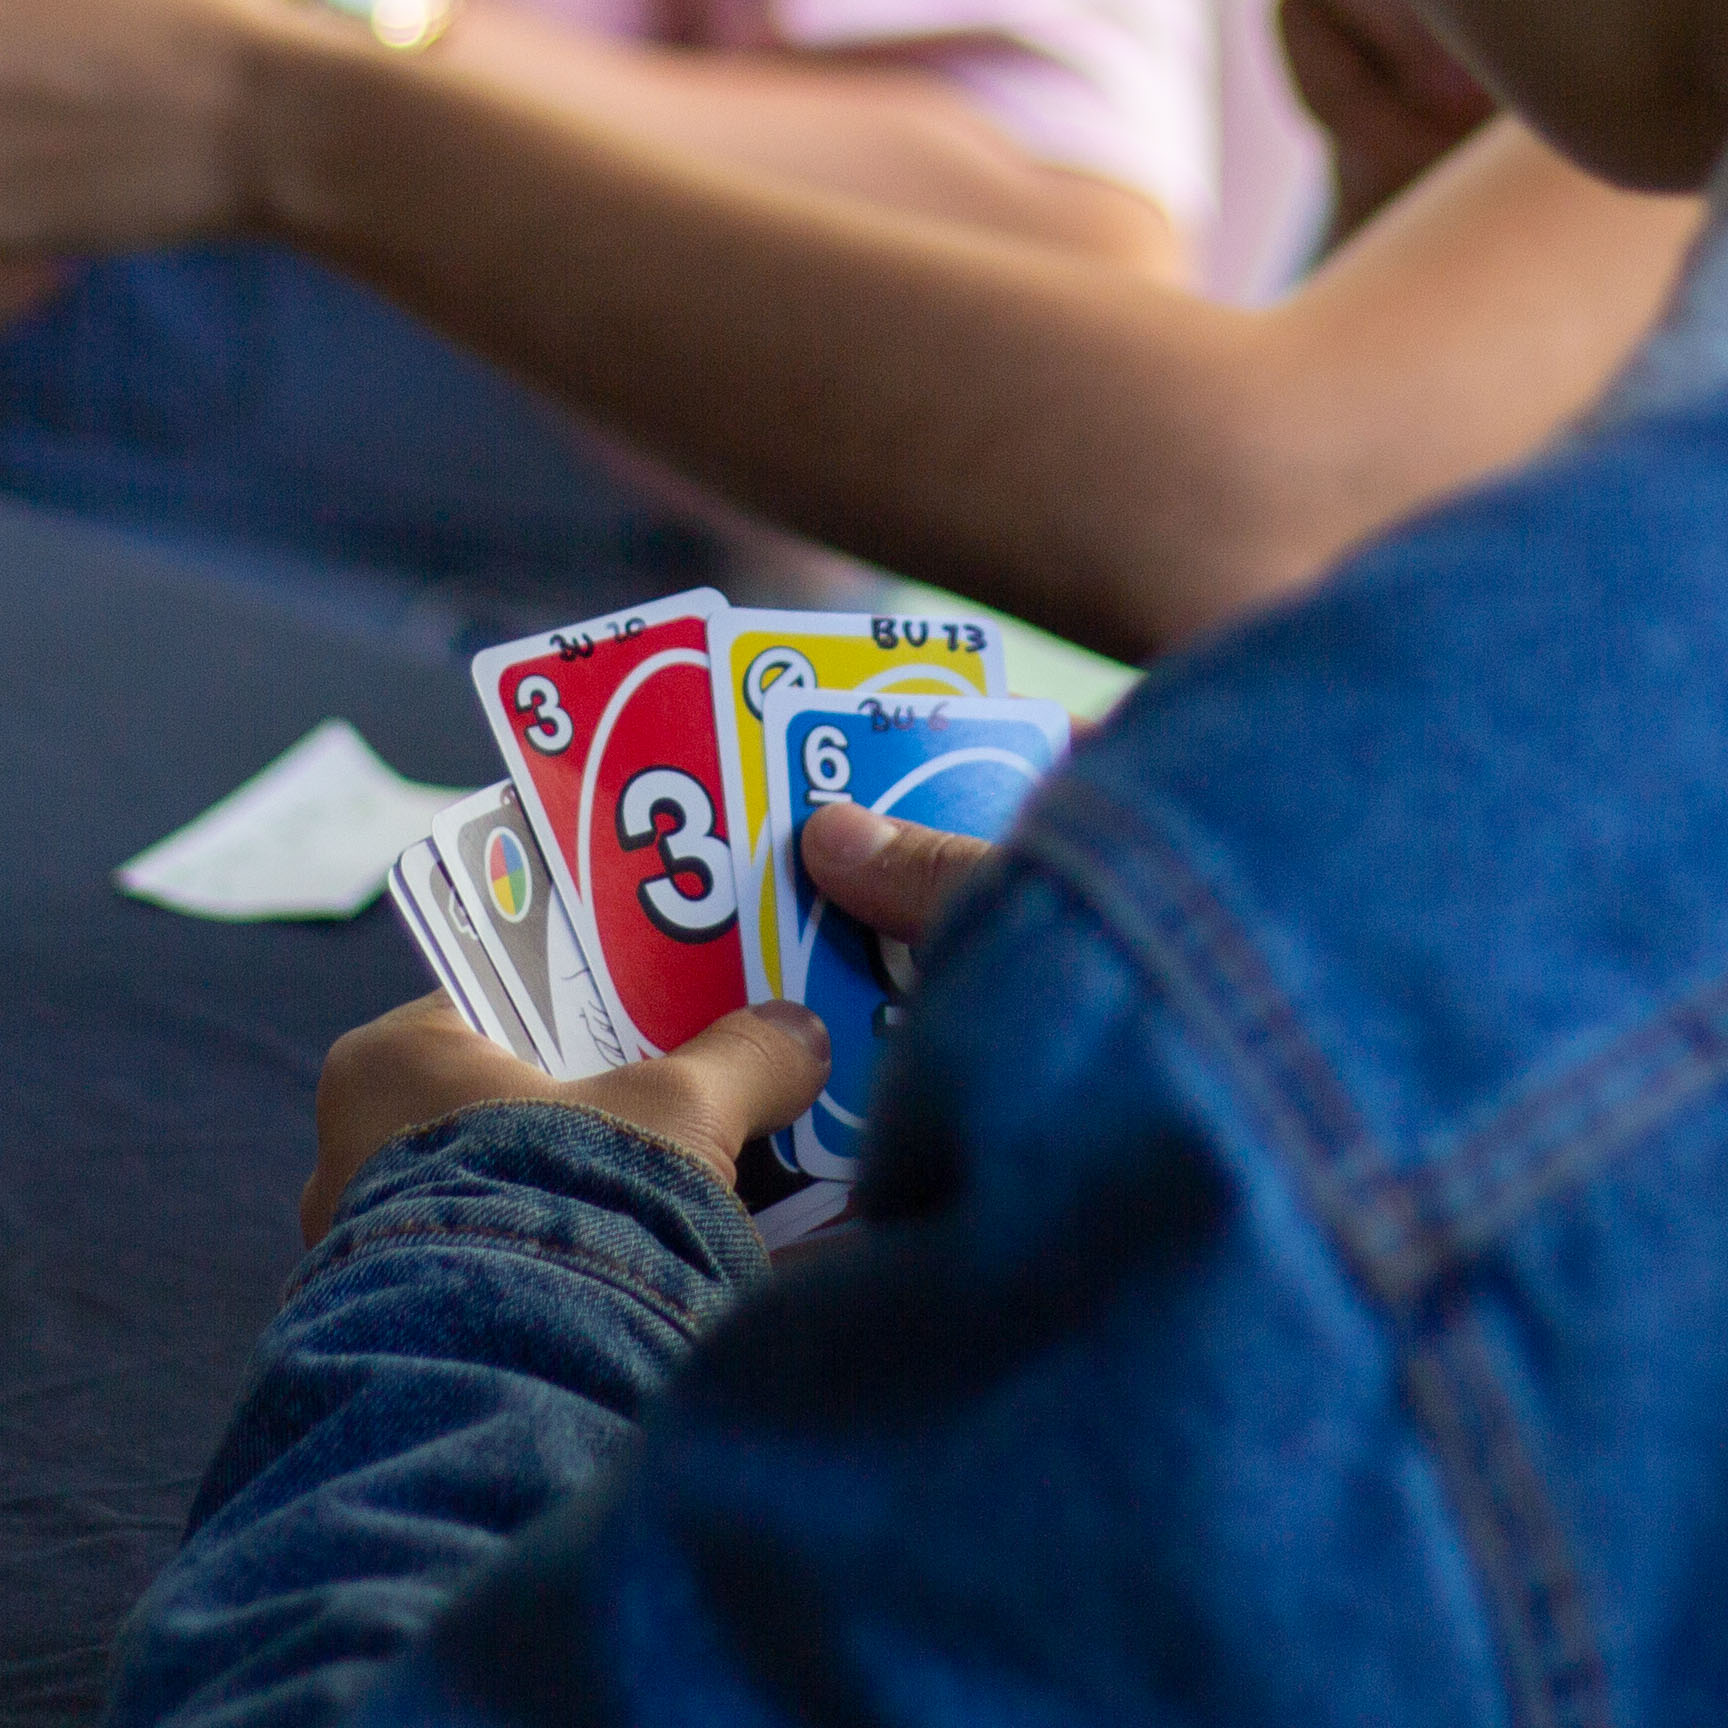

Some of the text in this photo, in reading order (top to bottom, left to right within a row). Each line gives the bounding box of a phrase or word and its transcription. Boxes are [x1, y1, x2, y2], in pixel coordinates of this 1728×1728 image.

[870, 617, 988, 653] BU 13
[514, 674, 574, 757] 3
[801, 724, 852, 794] 6
[614, 763, 740, 946] 3
